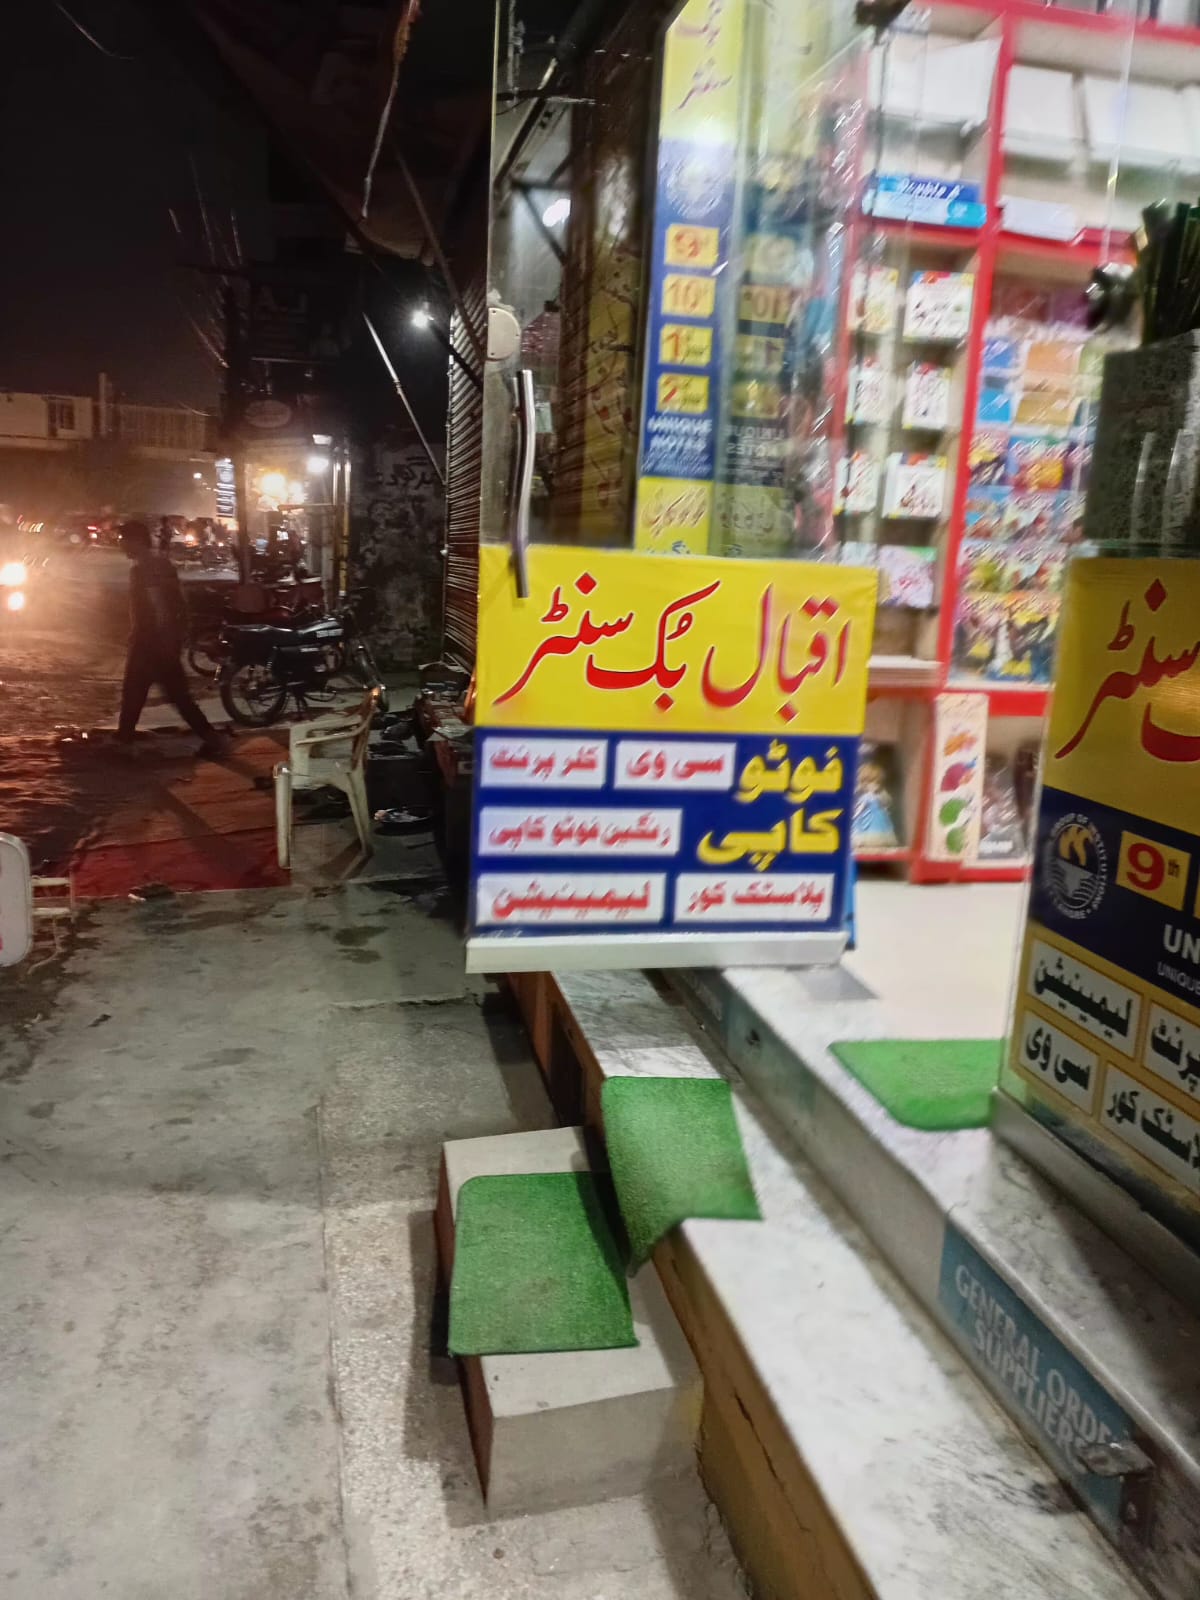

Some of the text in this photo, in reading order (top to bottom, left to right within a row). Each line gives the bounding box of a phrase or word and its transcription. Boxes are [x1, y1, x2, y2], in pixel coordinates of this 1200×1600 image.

[492, 572, 635, 707] سنٹر
[700, 581, 851, 723] اقبال
[734, 738, 844, 804] فوٹو
[696, 808, 844, 871] کاپی
[1053, 1053, 1091, 1091] سی
[955, 1264, 1041, 1383] GENERAL
